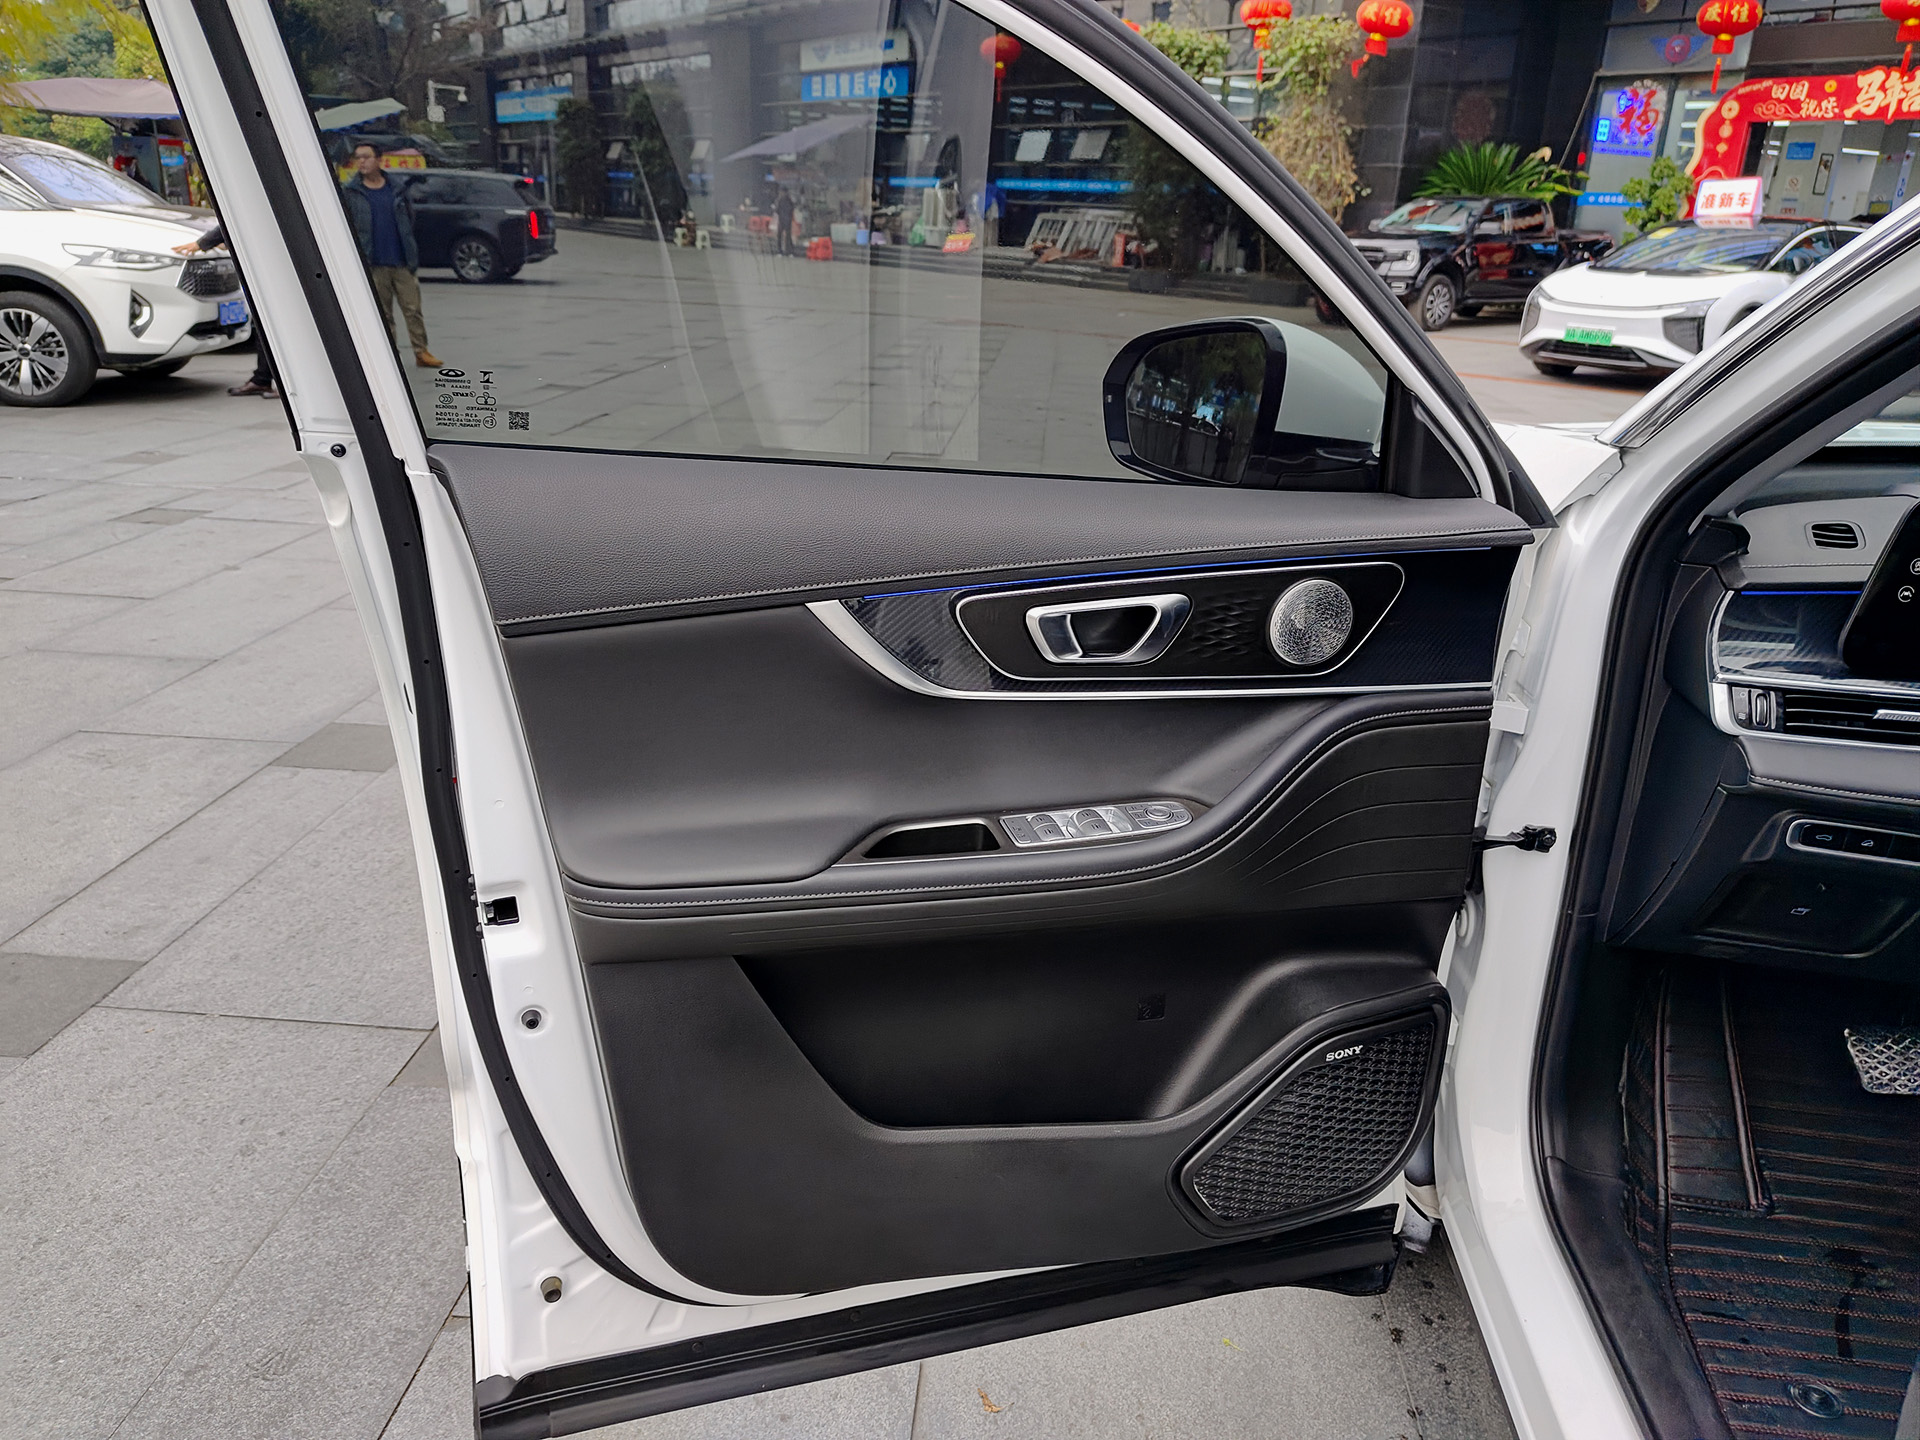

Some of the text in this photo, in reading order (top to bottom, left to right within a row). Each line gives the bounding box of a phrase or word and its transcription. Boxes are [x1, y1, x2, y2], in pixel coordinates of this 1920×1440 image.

[1701, 192, 1752, 209] 准新车
[1326, 1045, 1363, 1062] SONY
